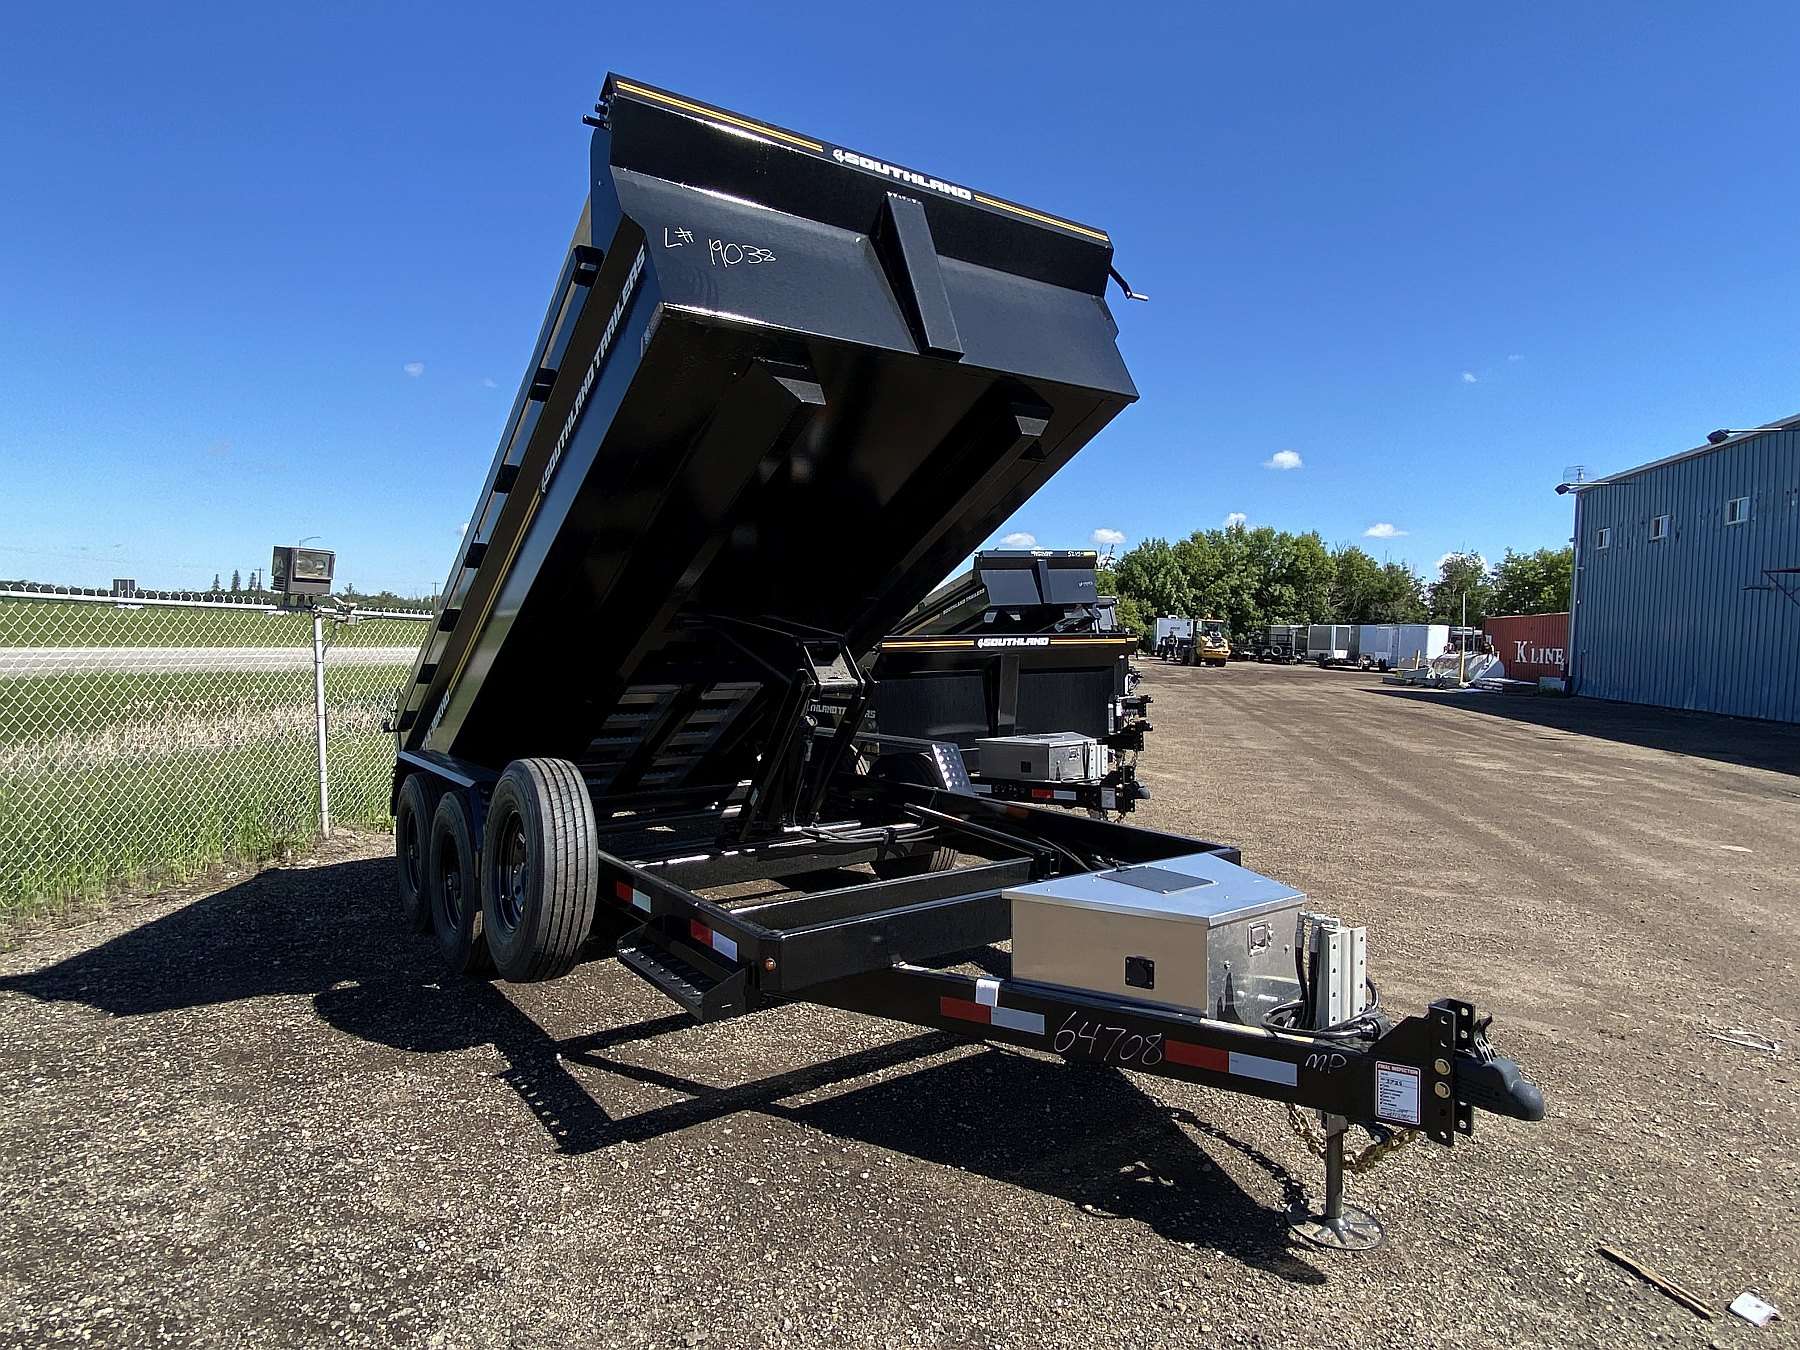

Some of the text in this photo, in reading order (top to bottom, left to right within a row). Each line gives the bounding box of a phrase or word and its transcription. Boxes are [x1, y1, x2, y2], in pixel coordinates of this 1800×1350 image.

[844, 151, 972, 201] SOUTHLAND
[708, 238, 777, 268] 19038
[543, 243, 646, 482] SOUTHLAND TRAILERS
[983, 637, 1050, 648] SOUTHLAND
[1053, 1010, 1162, 1065] 64708
